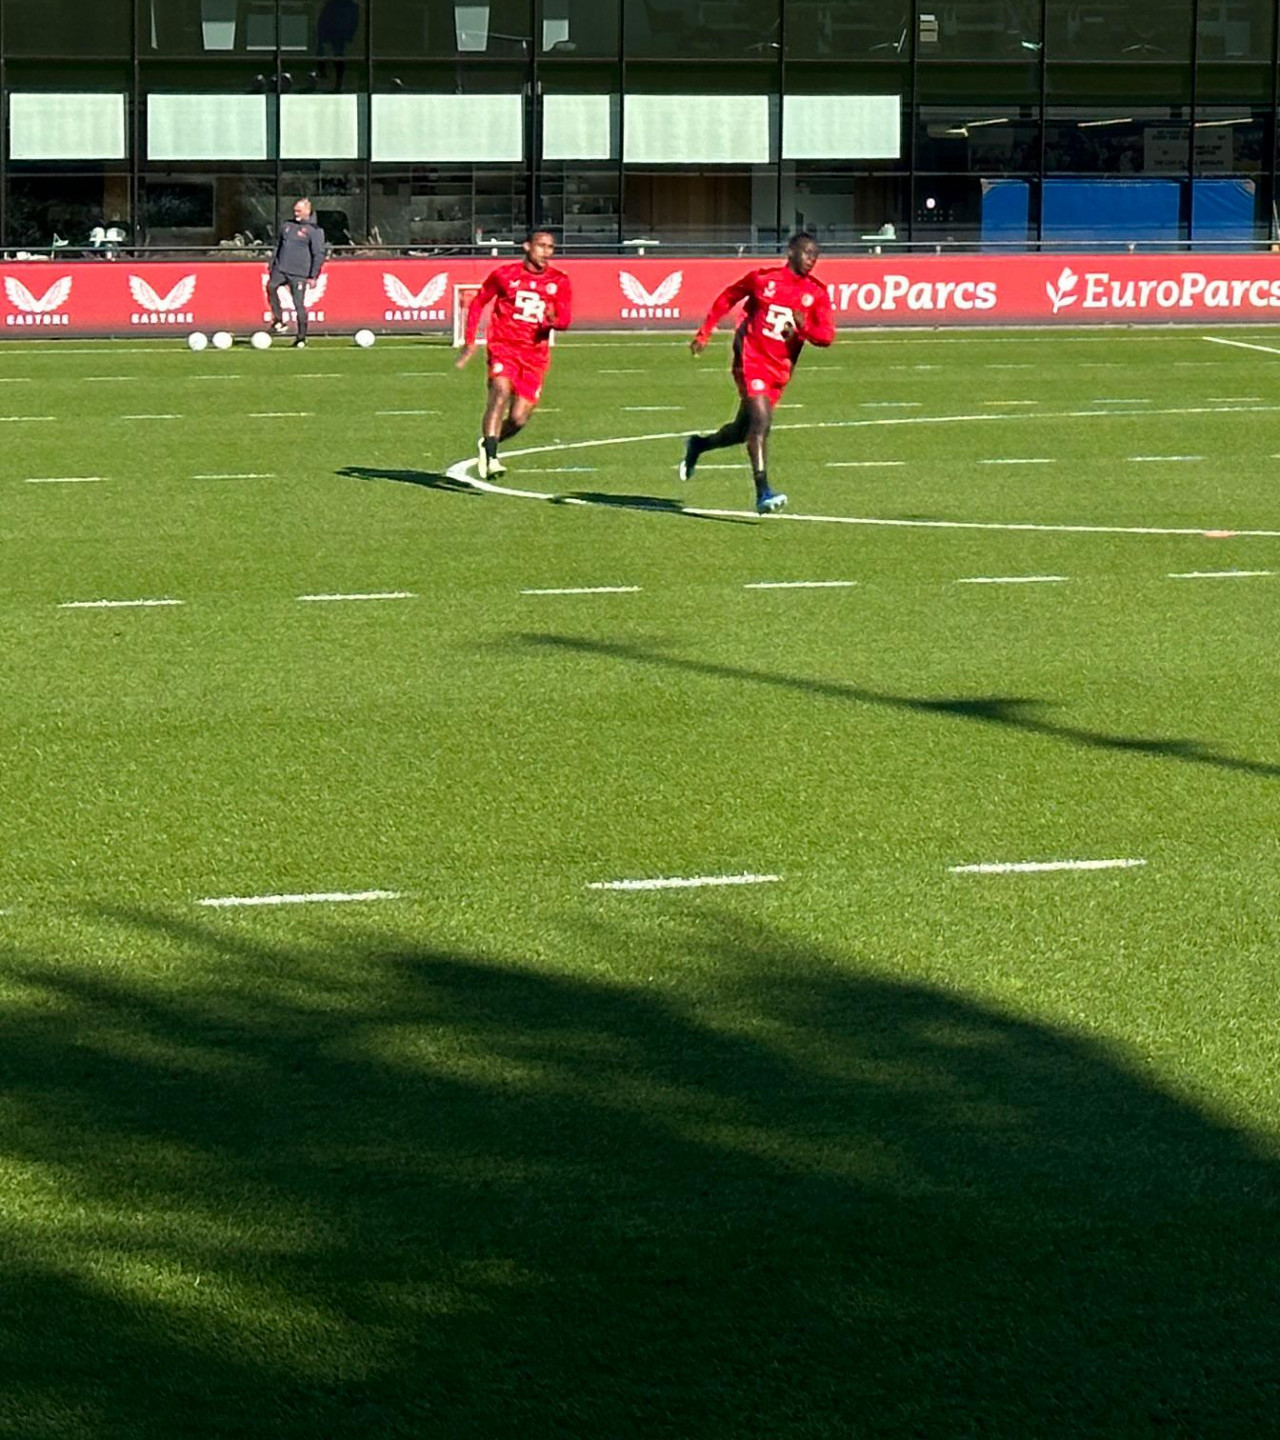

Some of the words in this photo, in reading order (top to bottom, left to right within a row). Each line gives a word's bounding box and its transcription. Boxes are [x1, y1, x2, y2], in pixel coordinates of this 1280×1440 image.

[827, 274, 997, 311] roParcs
[131, 312, 194, 324] CASTORE
[263, 311, 325, 322] CSTRE
[384, 310, 446, 321] CASTORE
[621, 308, 680, 318] CASTORE
[6, 313, 69, 325] CASTORE
